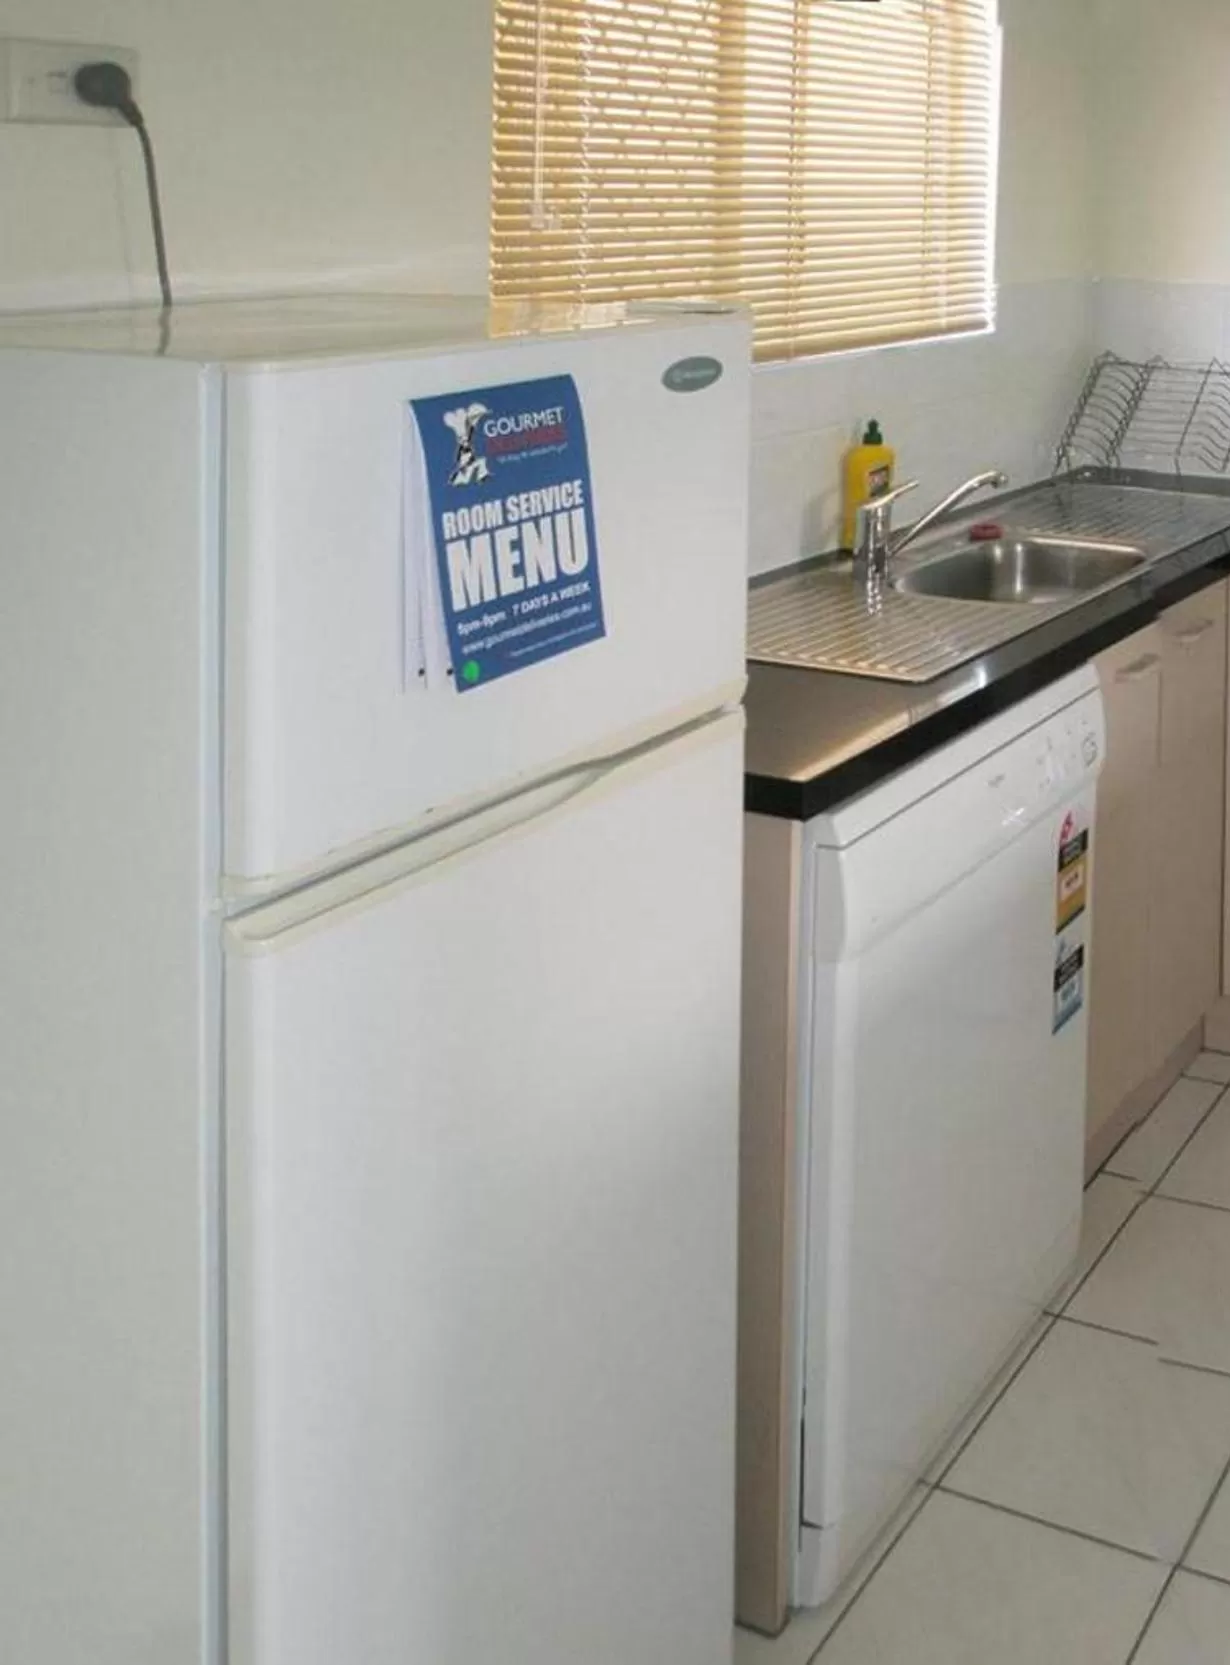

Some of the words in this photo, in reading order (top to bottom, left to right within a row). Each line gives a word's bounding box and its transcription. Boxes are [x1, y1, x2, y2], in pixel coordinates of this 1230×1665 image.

[483, 406, 564, 437] GOURMET
[442, 499, 504, 540] ROOM
[505, 479, 585, 523] SERVICE
[446, 507, 589, 613] MENU
[521, 593, 549, 614] DAYS
[550, 591, 559, 604] A
[559, 580, 592, 601] WEEK
